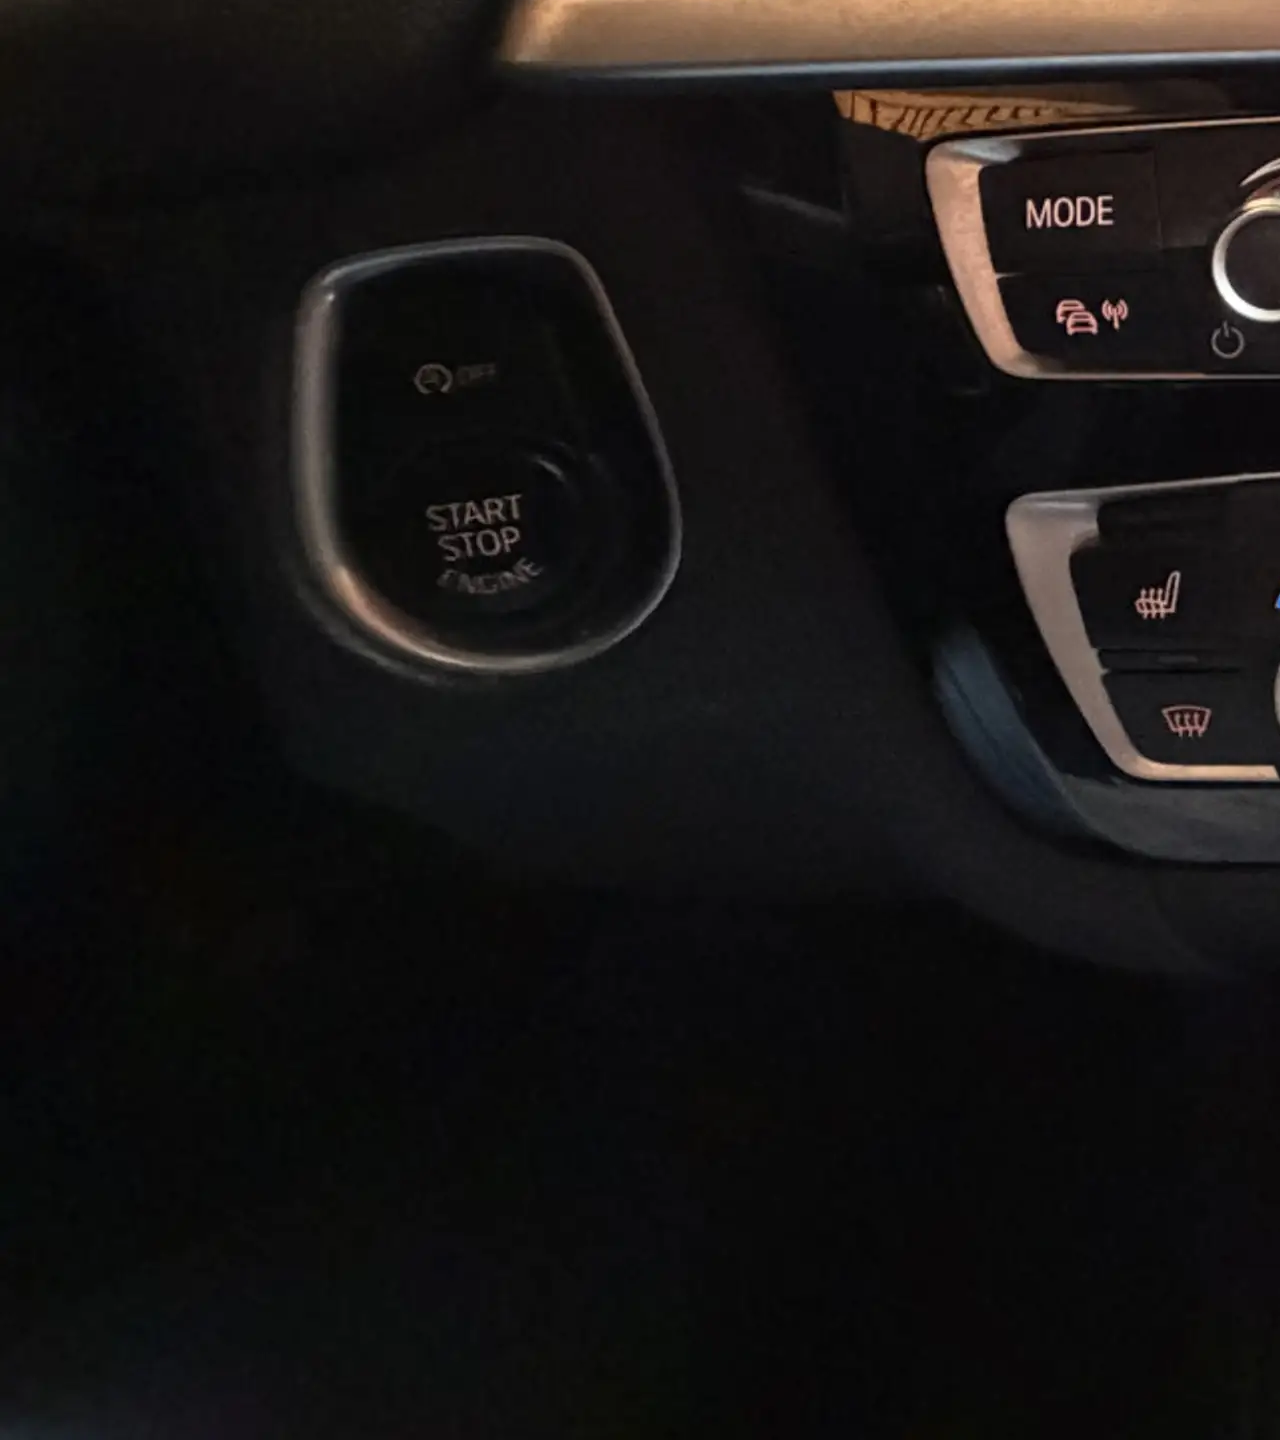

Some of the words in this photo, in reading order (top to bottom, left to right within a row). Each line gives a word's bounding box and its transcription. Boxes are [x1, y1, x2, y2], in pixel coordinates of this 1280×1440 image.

[1025, 195, 1114, 229] MODE
[425, 494, 523, 532] START
[437, 525, 521, 562] STOP
